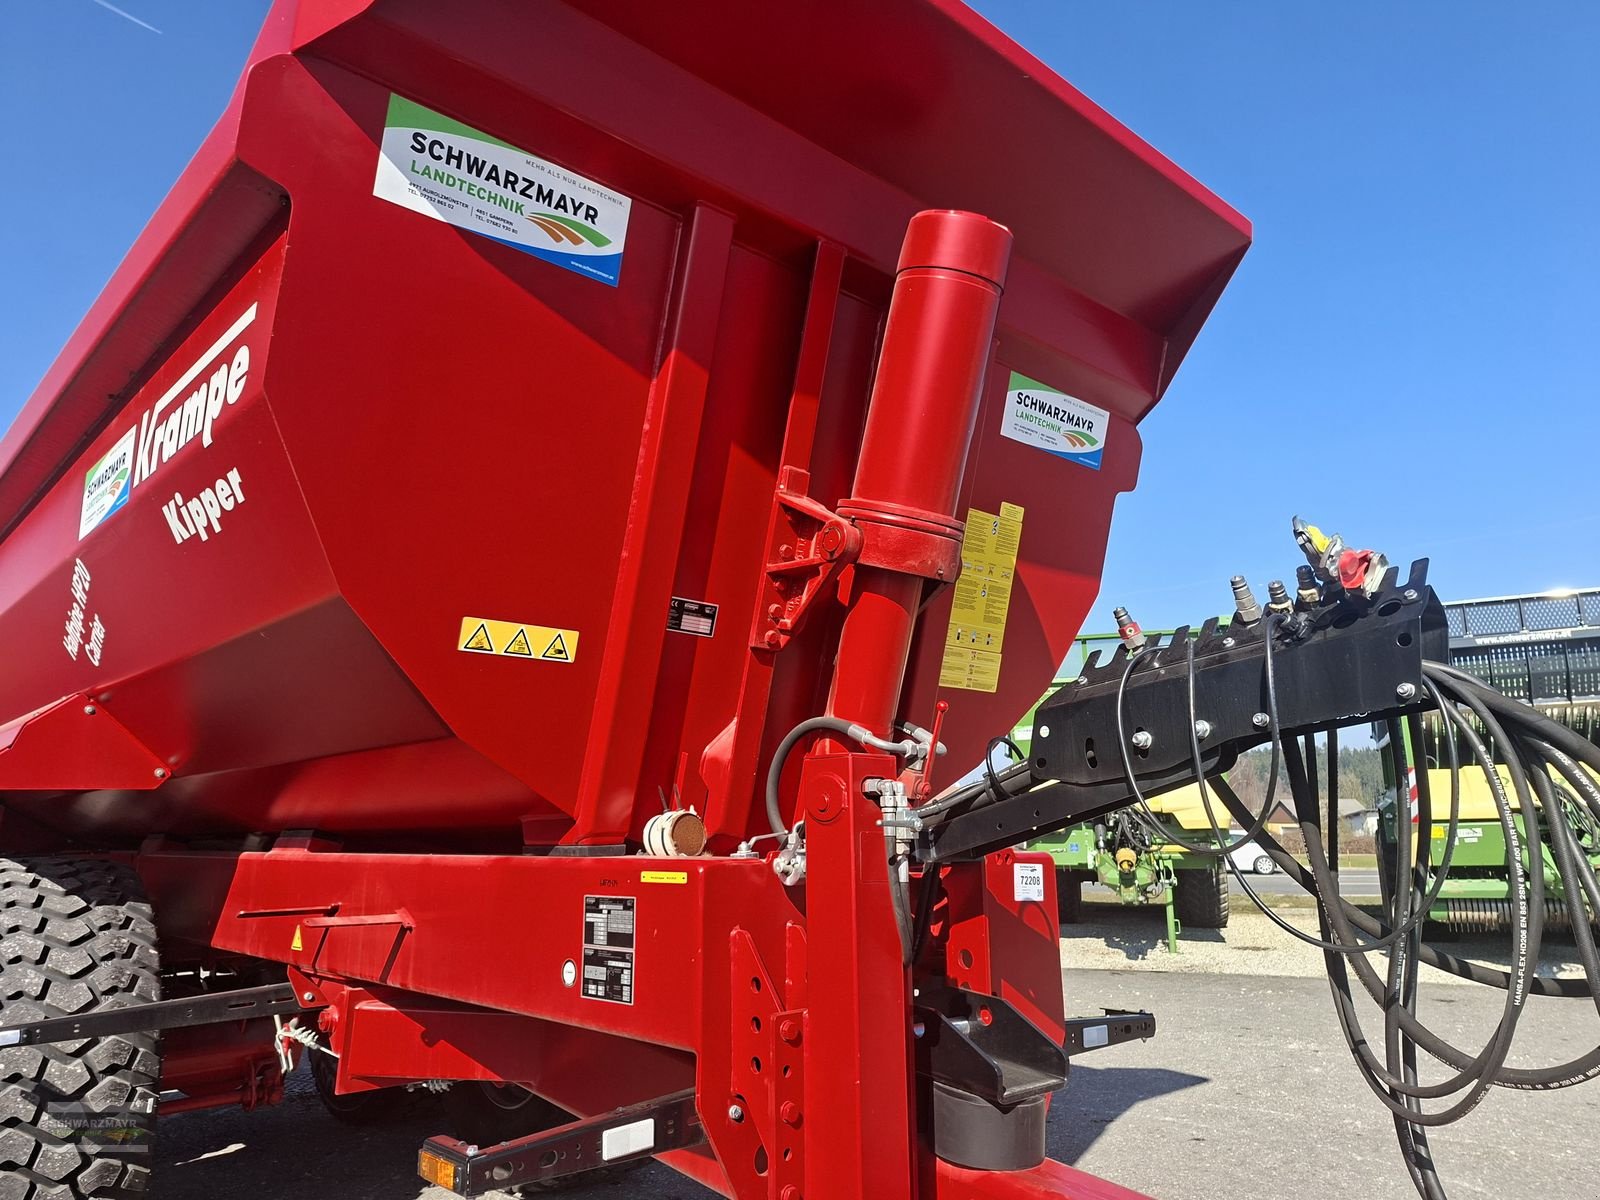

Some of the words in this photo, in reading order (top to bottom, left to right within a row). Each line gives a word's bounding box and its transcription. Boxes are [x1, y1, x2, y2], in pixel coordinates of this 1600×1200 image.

[409, 131, 600, 226] SCHWARZMAYR
[525, 159, 545, 171] MEHR
[547, 169, 560, 178] ALS
[562, 175, 577, 185] NUR
[410, 159, 526, 217] LANDTECHNIK
[133, 343, 251, 489] Krampe
[1015, 409, 1062, 435] LANDTECHNIK
[1016, 391, 1095, 433] SCHWARZMAYR
[86, 451, 127, 499] SCHWARZMAYR
[161, 466, 246, 545] Kipper
[70, 557, 91, 610] HP20
[1504, 805, 1515, 829] MSHA
[1510, 830, 1520, 846] BAR
[1020, 876, 1041, 886] 72208
[1516, 862, 1524, 877] WP
[1518, 882, 1526, 900] 2SN
[1519, 915, 1528, 928] EN
[1513, 956, 1527, 1006] HANSA-FLEX
[1570, 1074, 1586, 1084] BAR
